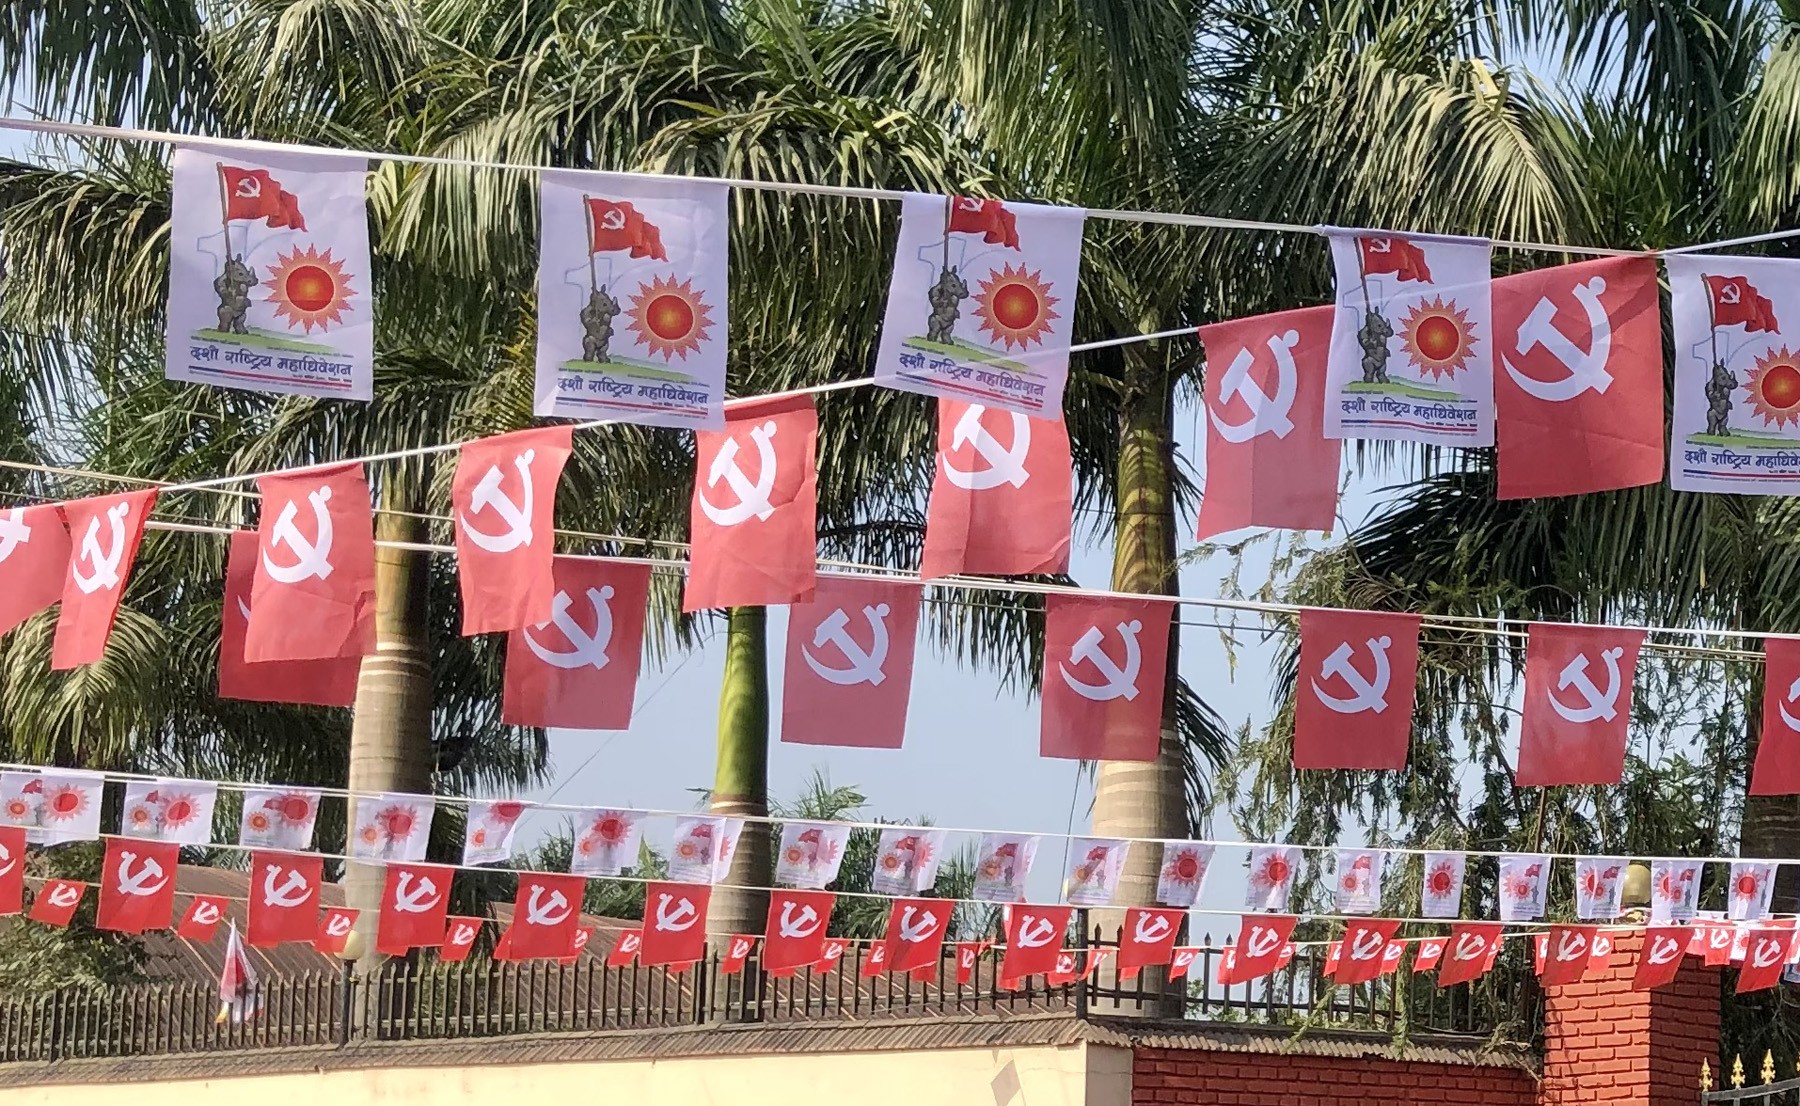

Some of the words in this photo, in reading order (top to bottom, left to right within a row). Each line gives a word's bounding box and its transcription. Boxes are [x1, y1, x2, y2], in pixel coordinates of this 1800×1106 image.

[276, 354, 353, 377] महाधिवेशन
[637, 383, 709, 405] महाधिवेशन
[1413, 403, 1477, 421] महाधिवेशन
